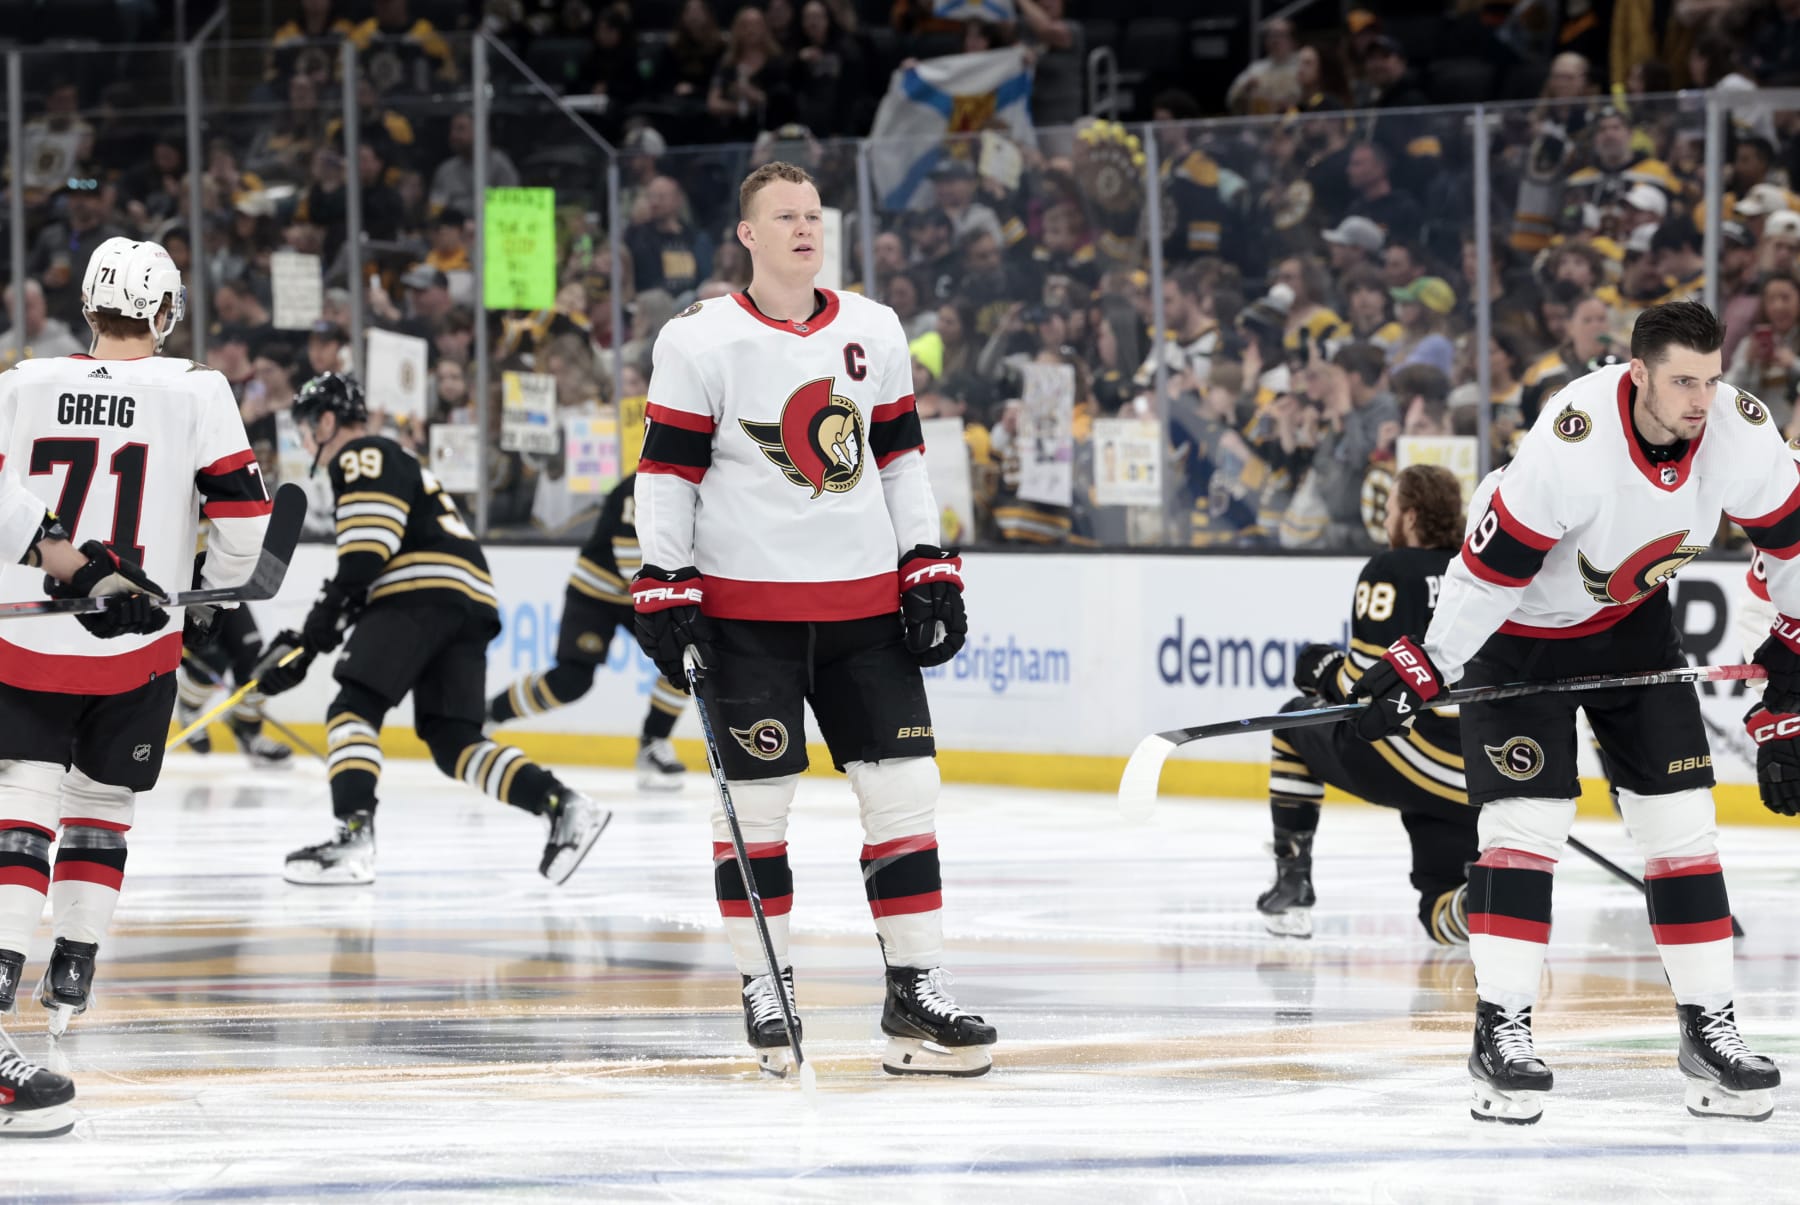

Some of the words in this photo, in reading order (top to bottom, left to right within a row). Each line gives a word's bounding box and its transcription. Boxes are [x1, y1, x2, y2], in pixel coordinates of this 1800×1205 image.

[101, 268, 116, 285] 71
[843, 342, 867, 382] C
[57, 392, 136, 428] GREIG
[338, 447, 383, 484] 39
[29, 436, 149, 570] 71
[665, 573, 677, 581] 7
[632, 587, 704, 604] TRUE
[1157, 616, 1350, 688] dema
[759, 728, 779, 752] S
[1512, 747, 1532, 772] S
